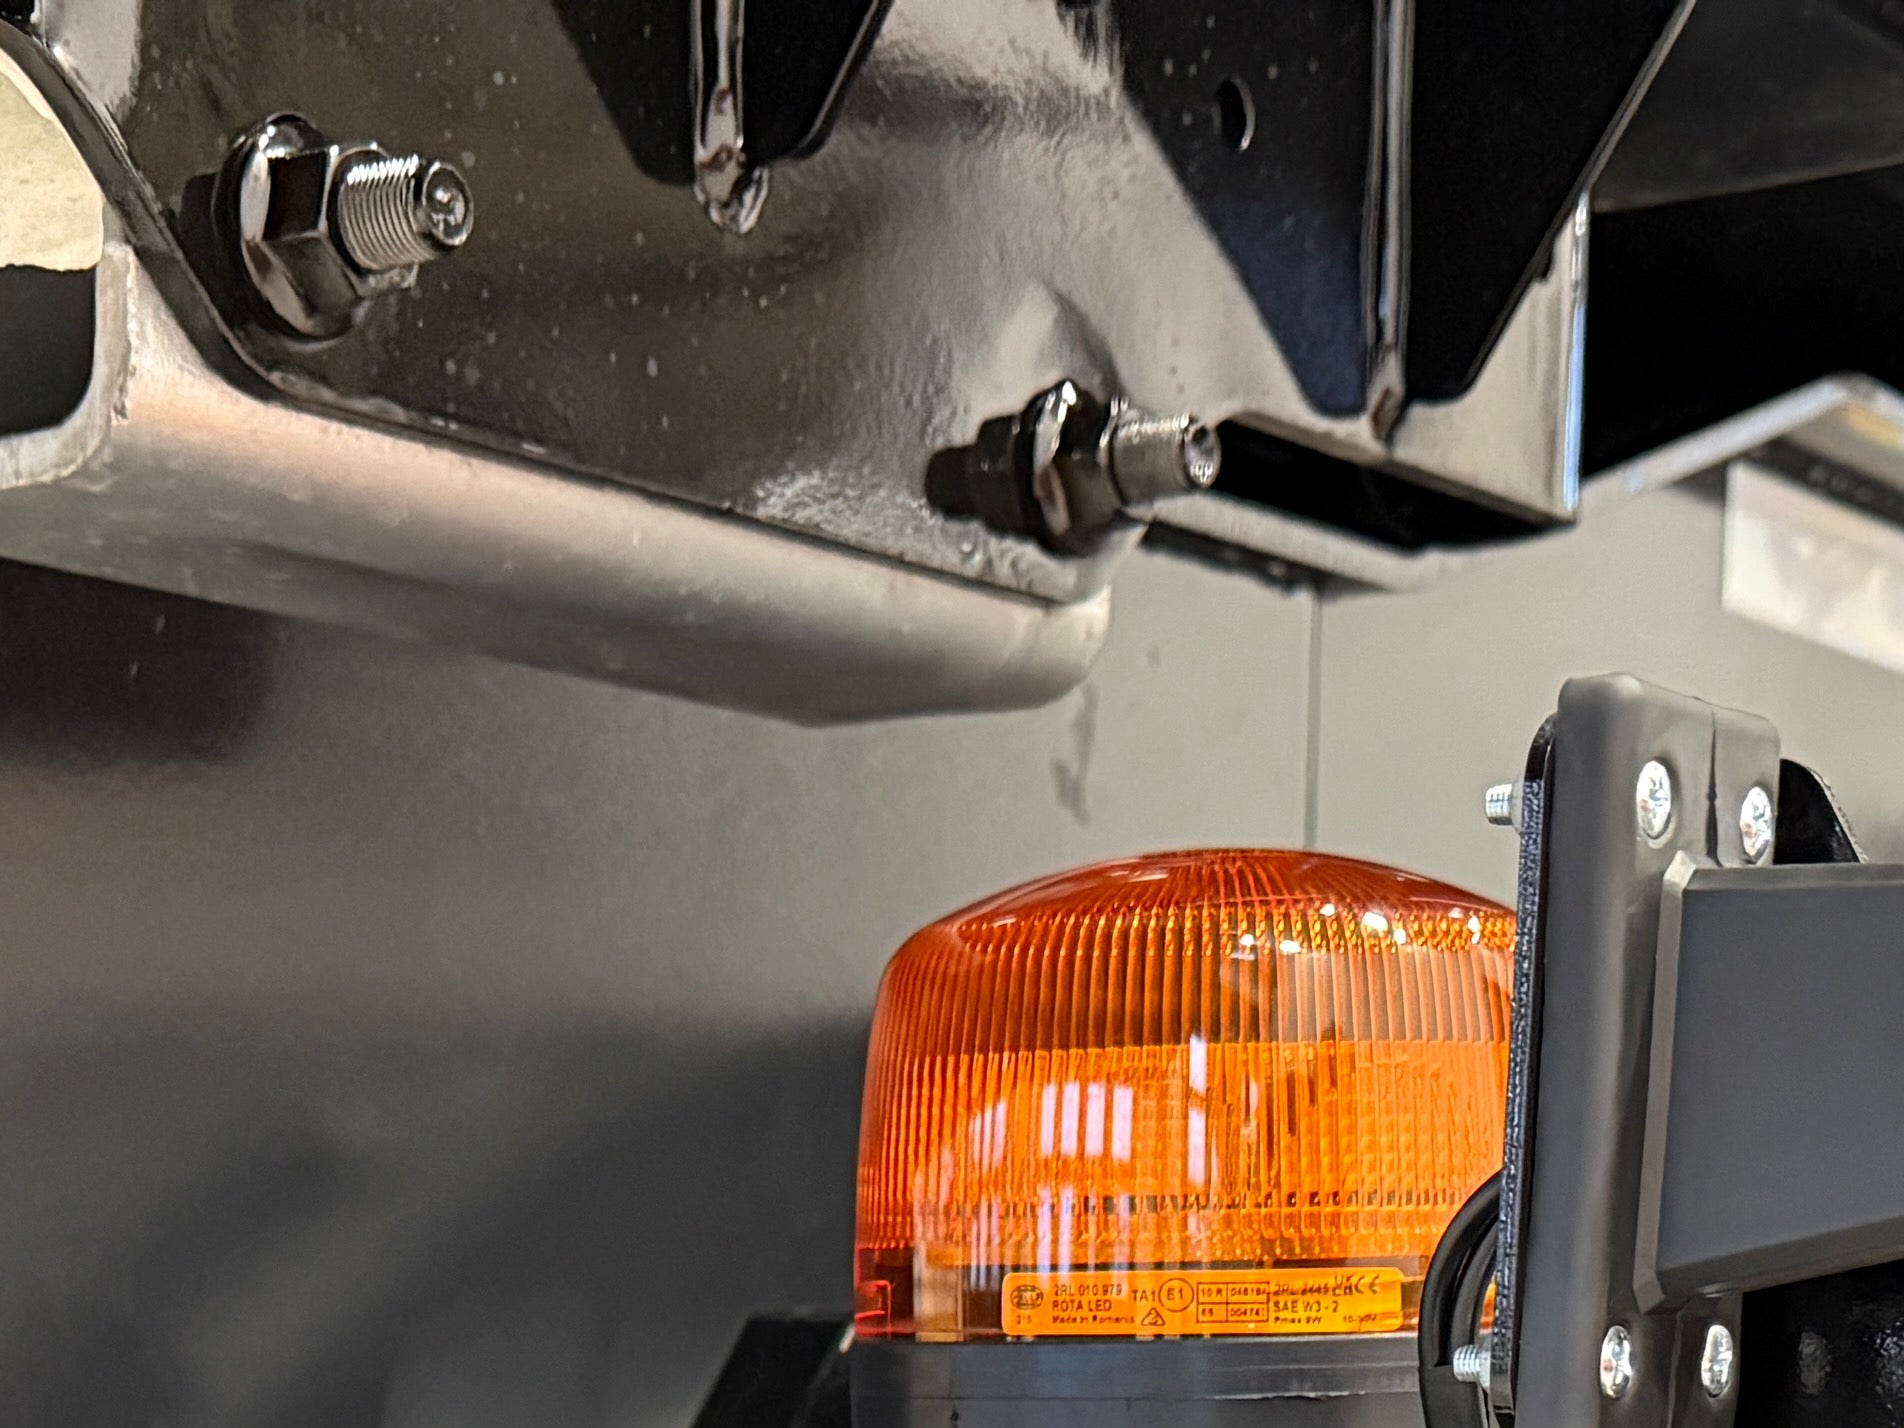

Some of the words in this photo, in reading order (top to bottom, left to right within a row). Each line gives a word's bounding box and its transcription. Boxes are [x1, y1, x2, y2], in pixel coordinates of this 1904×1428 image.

[1078, 1284, 1099, 1297] 010
[1166, 1287, 1184, 1302] E1
[1052, 1299, 1084, 1313] ROTA
[1087, 1299, 1113, 1313] LED
[1273, 1299, 1299, 1313] SAE
